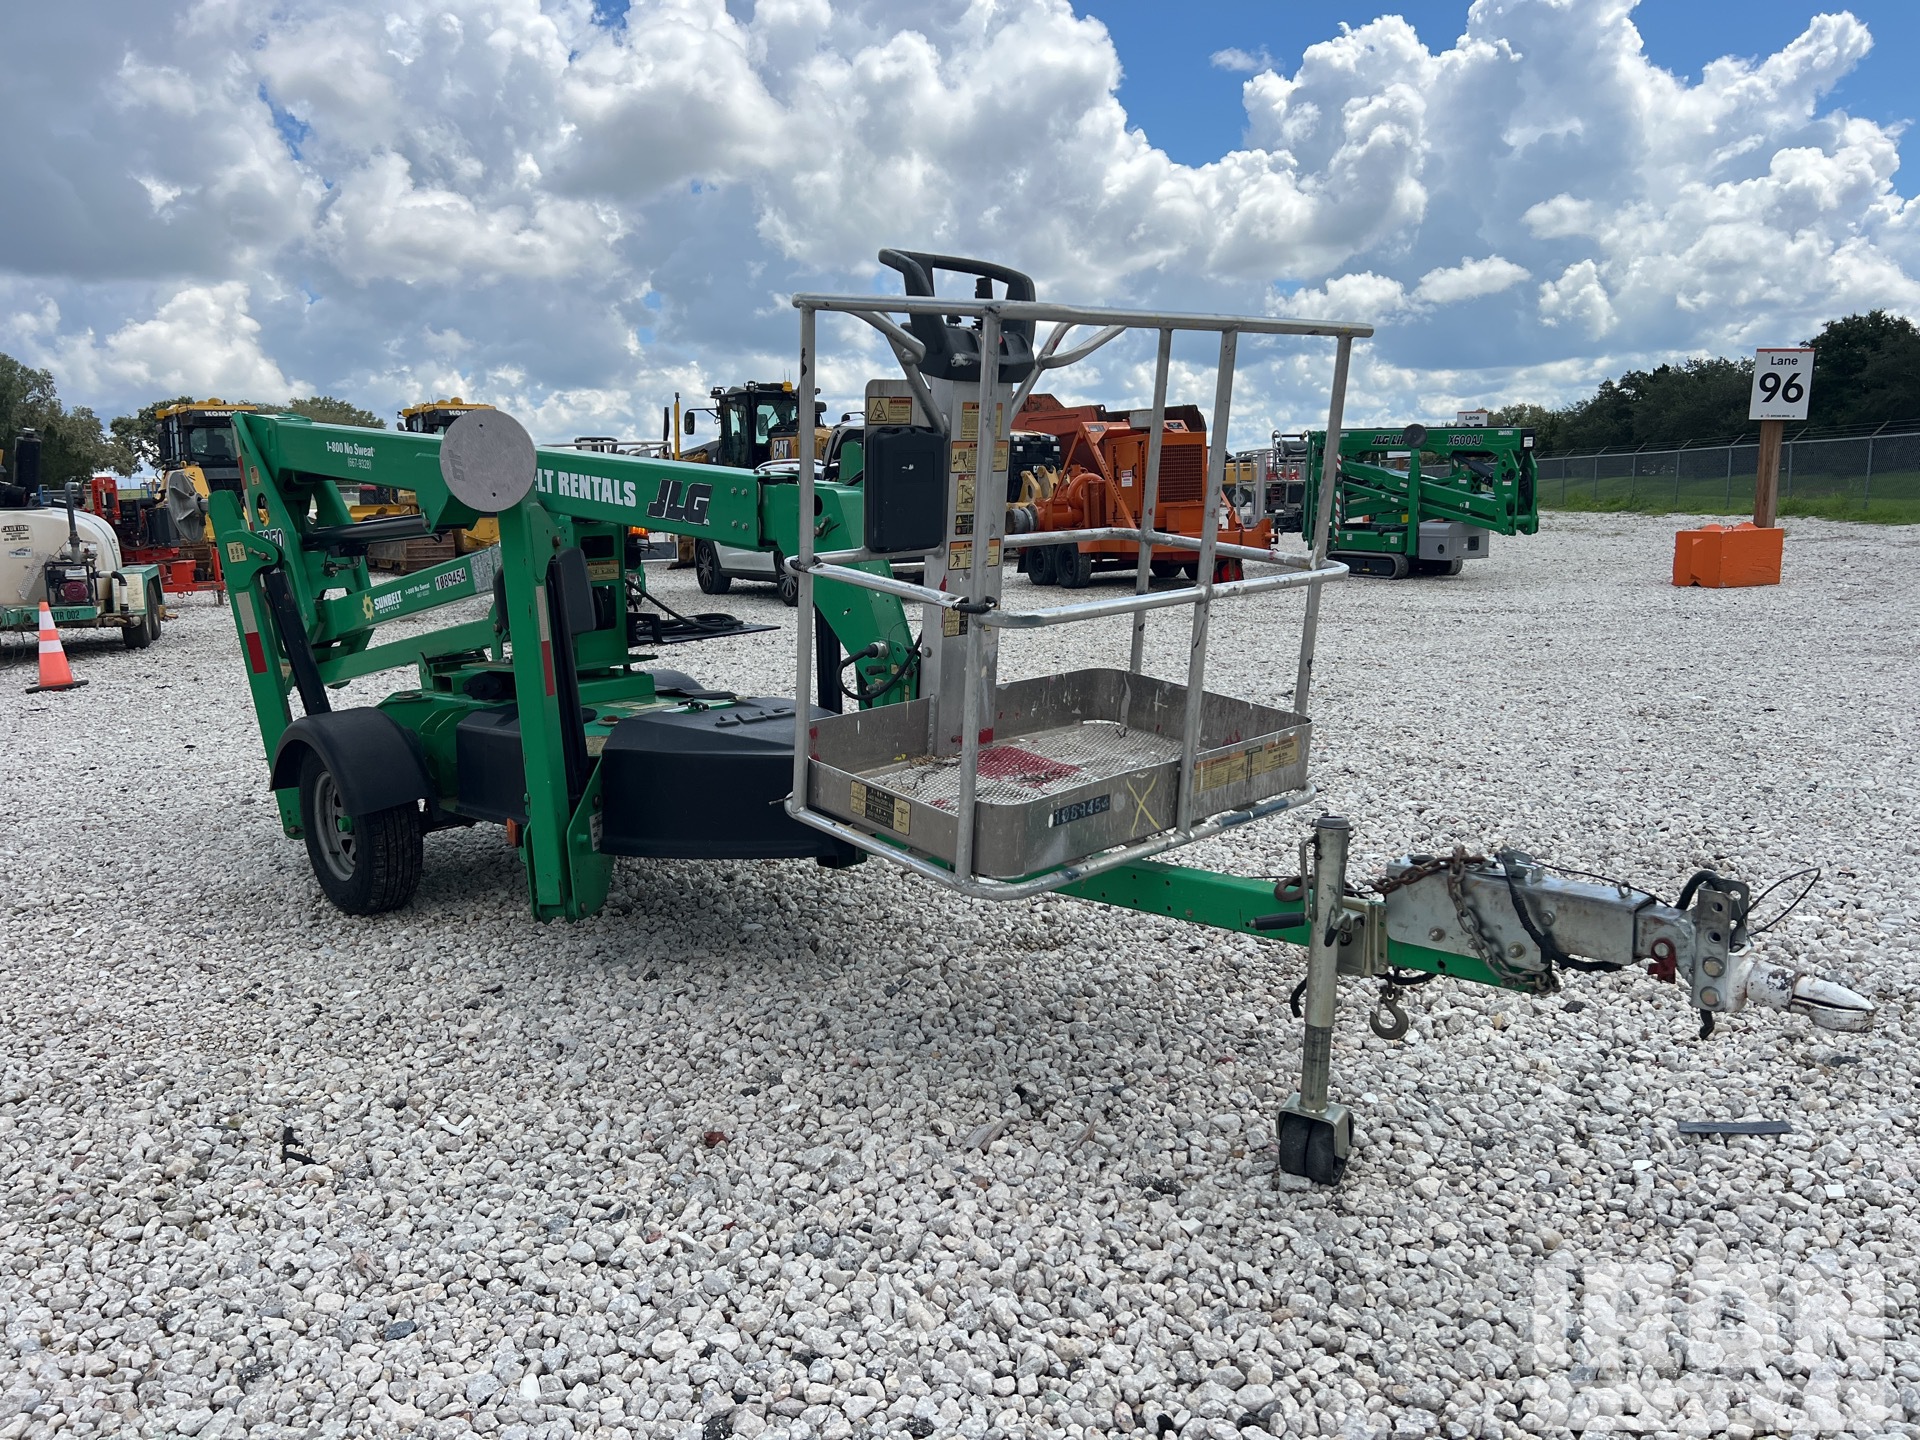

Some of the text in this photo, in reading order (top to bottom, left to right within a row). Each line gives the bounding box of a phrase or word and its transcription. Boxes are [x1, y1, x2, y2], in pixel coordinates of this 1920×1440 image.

[1770, 356, 1798, 366] Lane
[1758, 372, 1804, 404] 96
[1371, 435, 1390, 445] JLG
[1447, 434, 1483, 446] X600AJ
[326, 441, 374, 457] 1-800 No Sweat
[773, 440, 789, 460] CAT
[535, 468, 637, 508] LT RENTALS
[646, 479, 713, 526] JLG
[1, 525, 29, 533] CAUTION
[435, 567, 466, 590] 1089454
[374, 590, 402, 611] SUNBELT
[67, 610, 80, 619] 002
[379, 604, 400, 614] RENTALS
